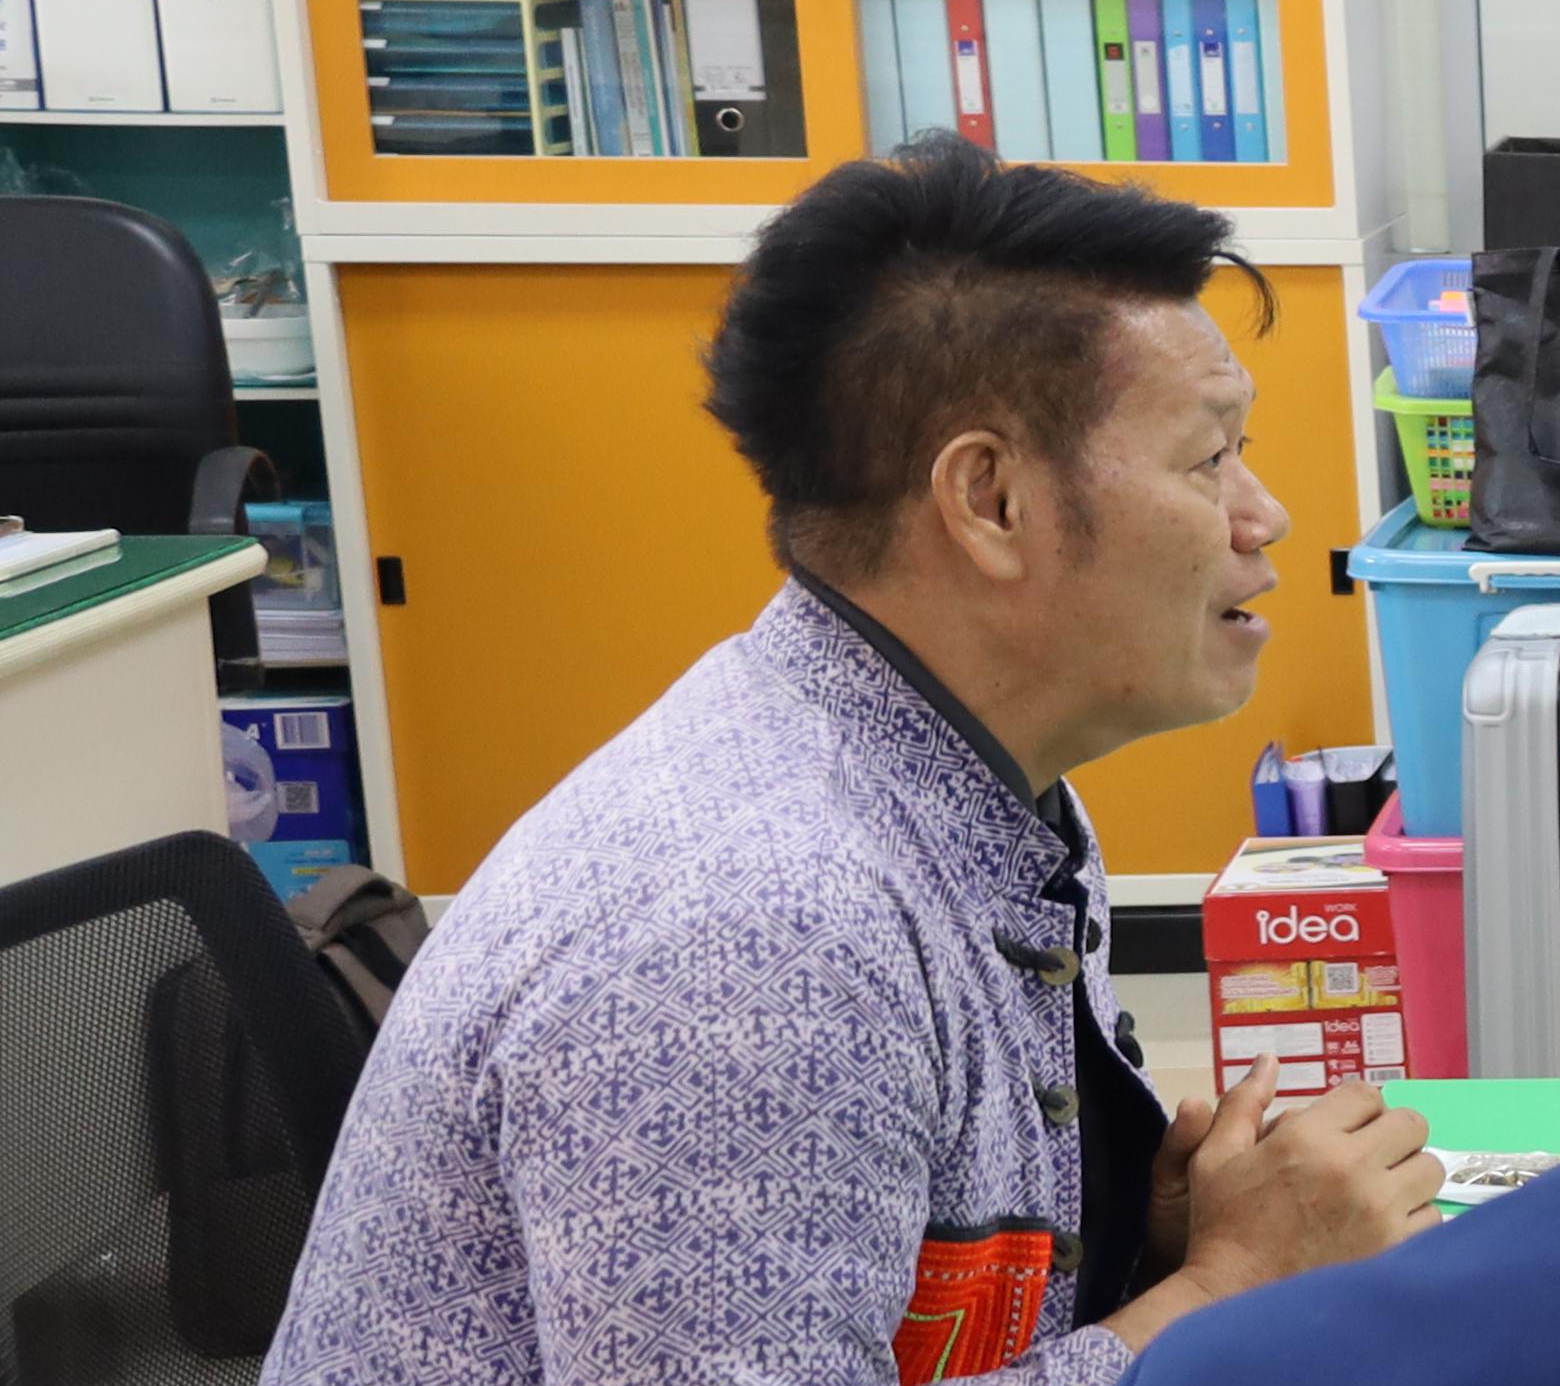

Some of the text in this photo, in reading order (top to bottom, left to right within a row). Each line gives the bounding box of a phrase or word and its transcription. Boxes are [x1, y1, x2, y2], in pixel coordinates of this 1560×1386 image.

[1324, 903, 1358, 913] WORK
[1256, 904, 1361, 945] idea
[1325, 1019, 1360, 1033] idea
